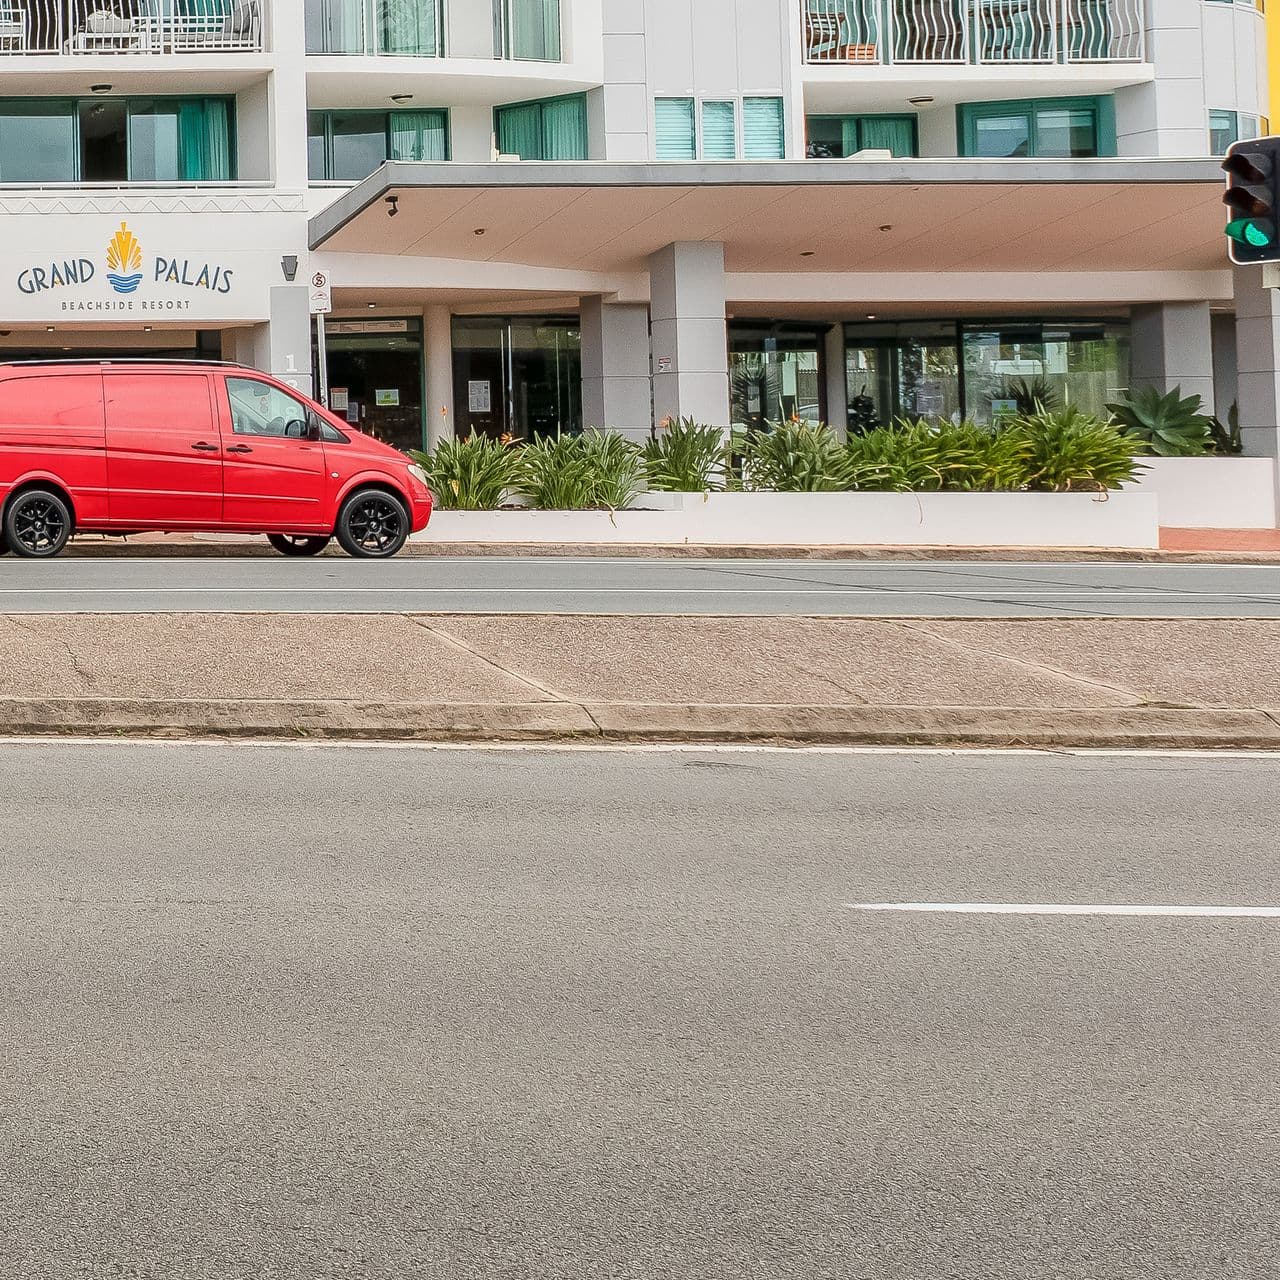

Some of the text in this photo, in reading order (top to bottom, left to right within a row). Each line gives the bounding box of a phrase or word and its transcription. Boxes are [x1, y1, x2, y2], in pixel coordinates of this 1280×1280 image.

[17, 256, 234, 295] GRAND PALAIS
[61, 300, 190, 311] BEACHSIDE RESORT
